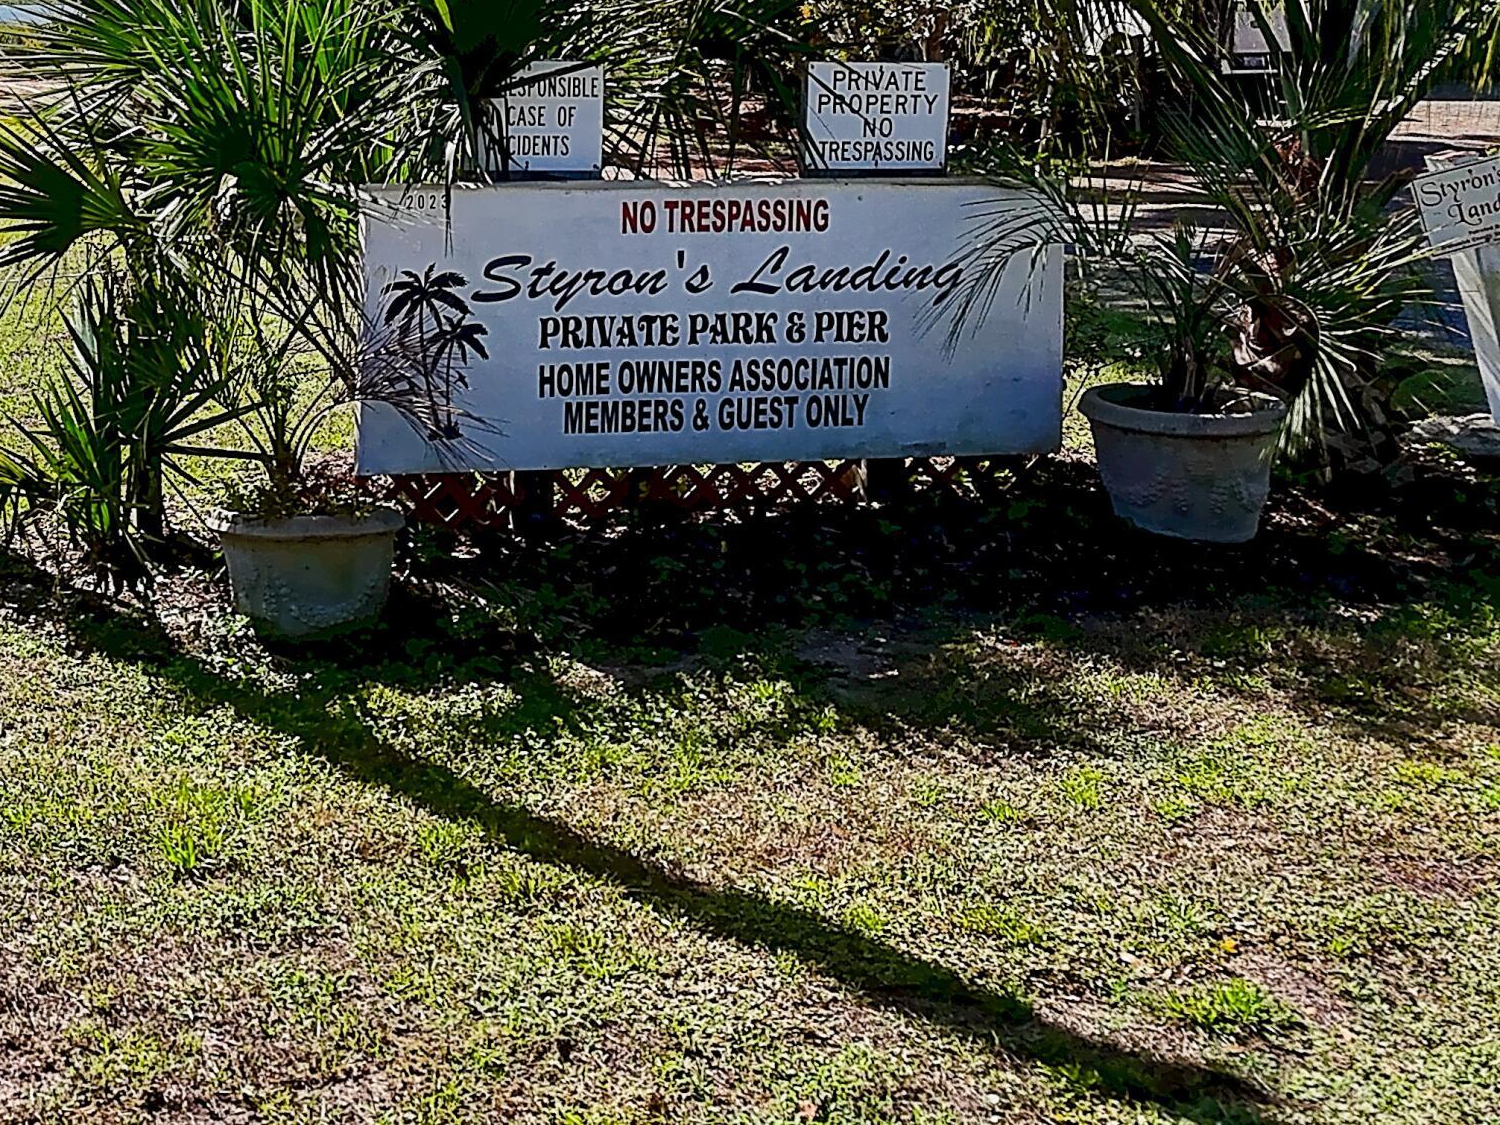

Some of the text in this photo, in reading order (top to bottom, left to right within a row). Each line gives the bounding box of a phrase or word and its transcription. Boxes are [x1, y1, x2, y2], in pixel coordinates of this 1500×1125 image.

[502, 76, 600, 98] ESPONSIBLE
[832, 70, 927, 92] PRIVATE
[817, 93, 939, 115] PROPERTY
[508, 105, 577, 127] CASE OF
[862, 117, 893, 139] NO
[505, 135, 570, 157] CIDENTS
[818, 140, 935, 162] TRESPASSING
[621, 199, 830, 234] NO TRESPASSING
[470, 246, 965, 312] Styron's Landing
[538, 310, 889, 349] PRIVATE PARK & PIER
[538, 356, 890, 398] HOME OWNERS ASSOCIATION
[563, 394, 870, 434] MEMBERS & GUEST ONLY
